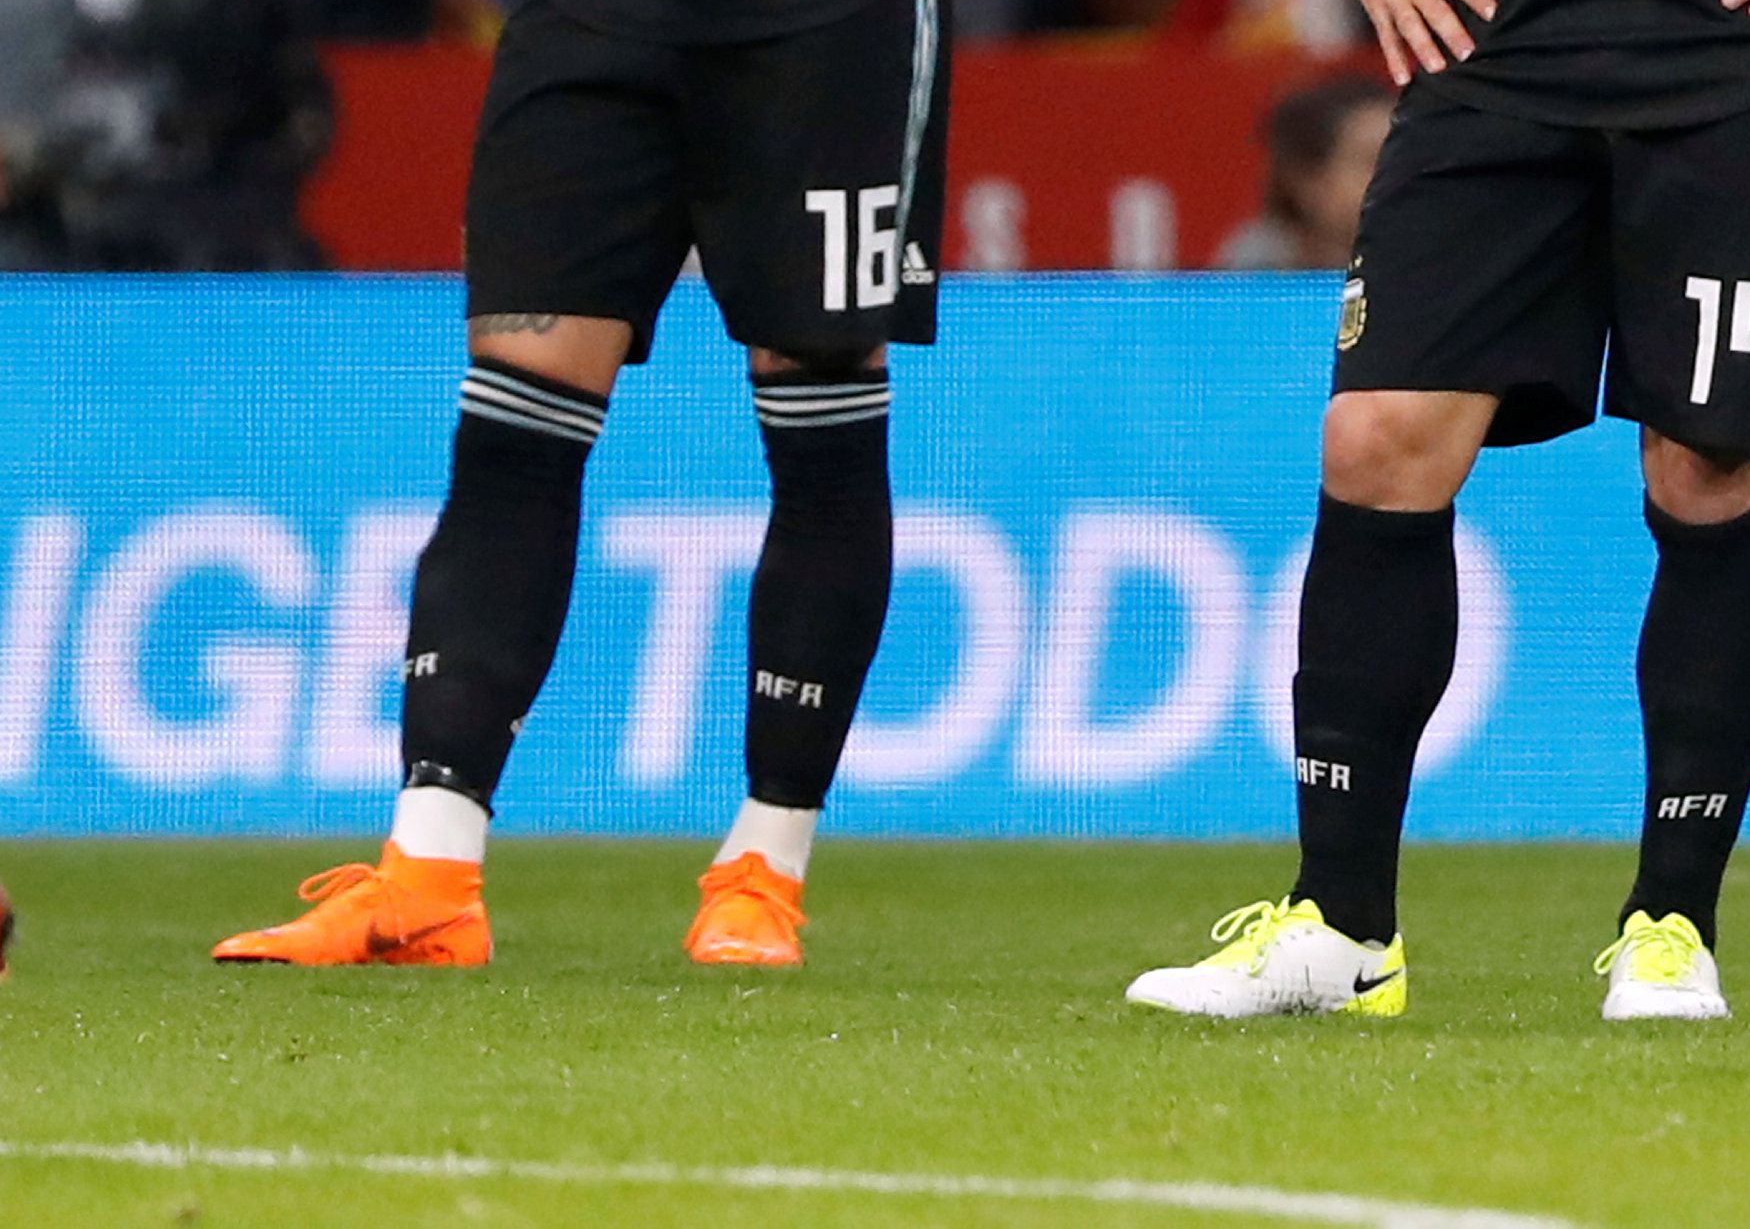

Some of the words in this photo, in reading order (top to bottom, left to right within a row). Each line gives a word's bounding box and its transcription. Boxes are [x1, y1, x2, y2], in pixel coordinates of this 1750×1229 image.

[805, 184, 900, 311] 16
[755, 669, 823, 709] AFA
[1296, 757, 1350, 791] AFA
[1657, 793, 1728, 819] AFA
